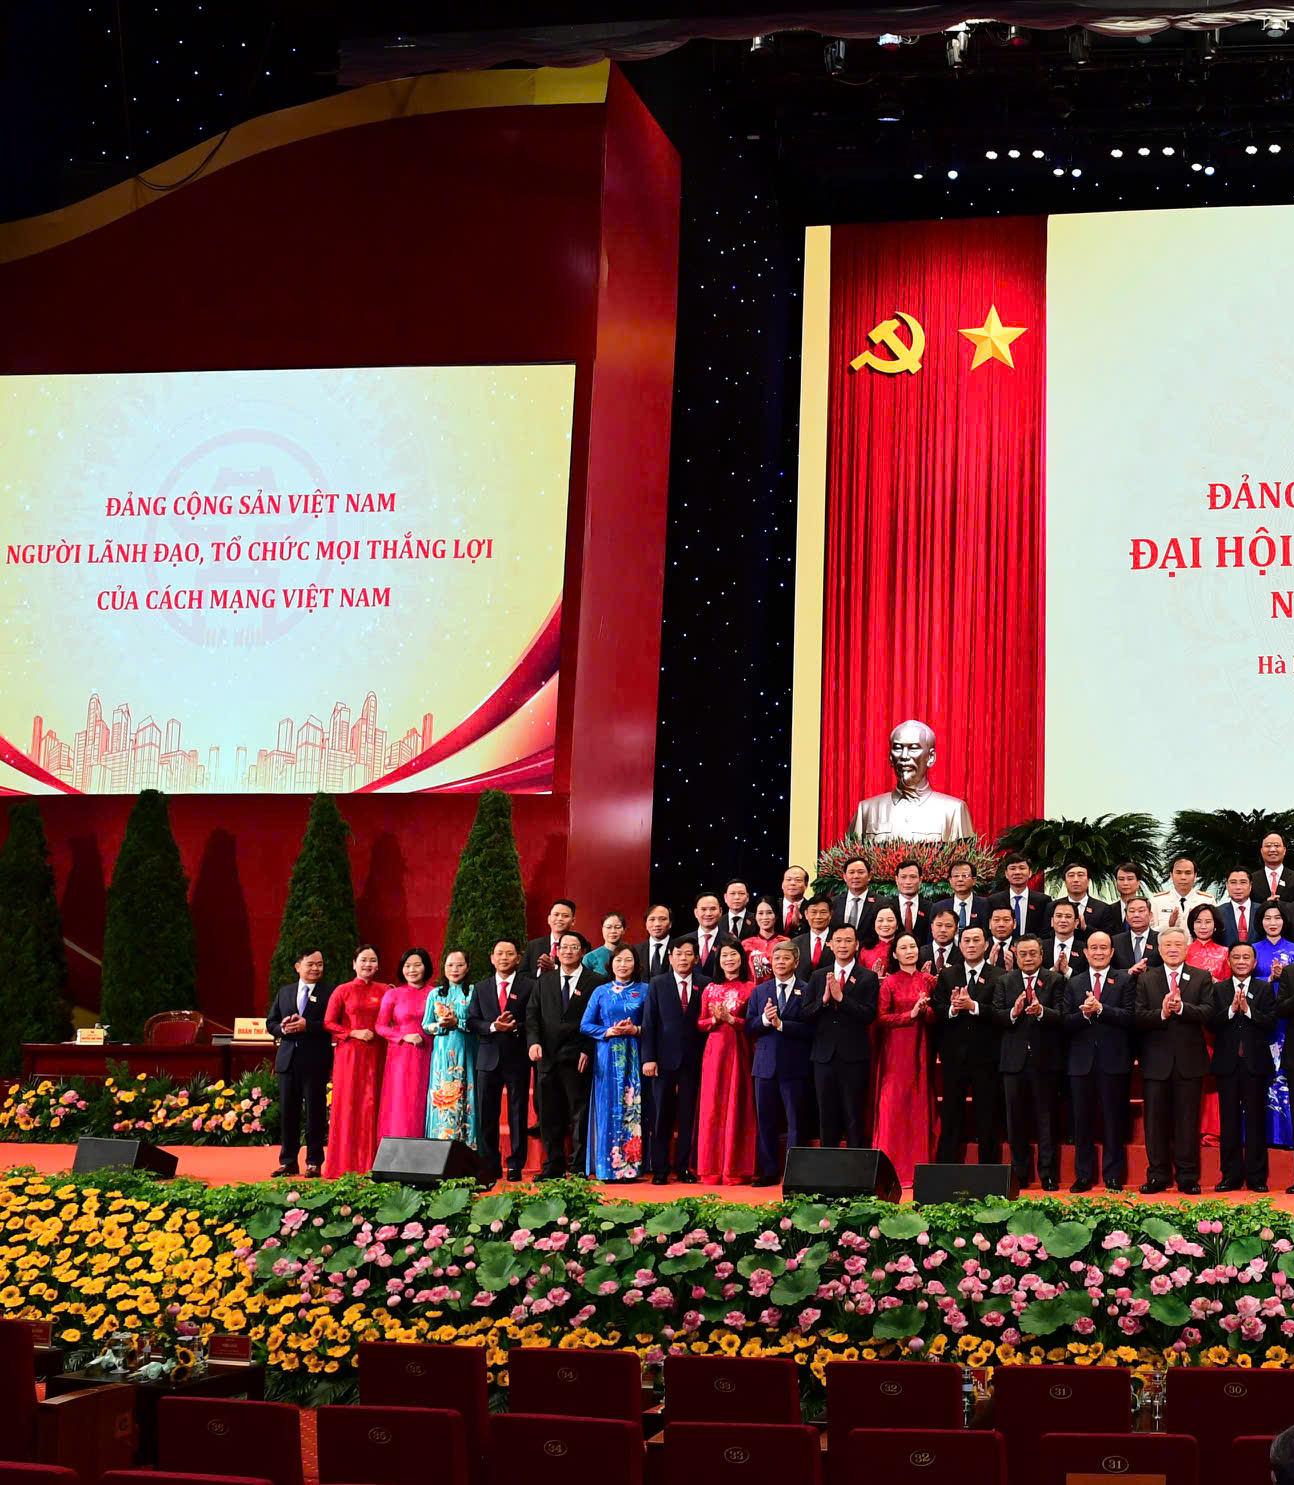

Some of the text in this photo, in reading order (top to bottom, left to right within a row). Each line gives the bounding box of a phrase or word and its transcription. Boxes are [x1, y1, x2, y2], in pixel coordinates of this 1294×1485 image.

[107, 489, 395, 519] ĐẢNG CỘNG SẢN VIỆT NAM
[7, 536, 493, 566] NGƯỜI LÃNH ĐẠO, TỔ CHỨC MỌI THẮNG LỢI
[1130, 537, 1201, 578] ĐẠI
[1217, 527, 1291, 576] HỘI
[98, 584, 390, 613] CỦA CÁCH MẠNG VIỆT NAM
[1259, 655, 1286, 674] Hà
[884, 1384, 898, 1393] 32
[1054, 1387, 1066, 1396] 31
[1228, 1385, 1242, 1394] 30
[914, 1452, 930, 1463] 32
[1108, 1459, 1122, 1469] 31
